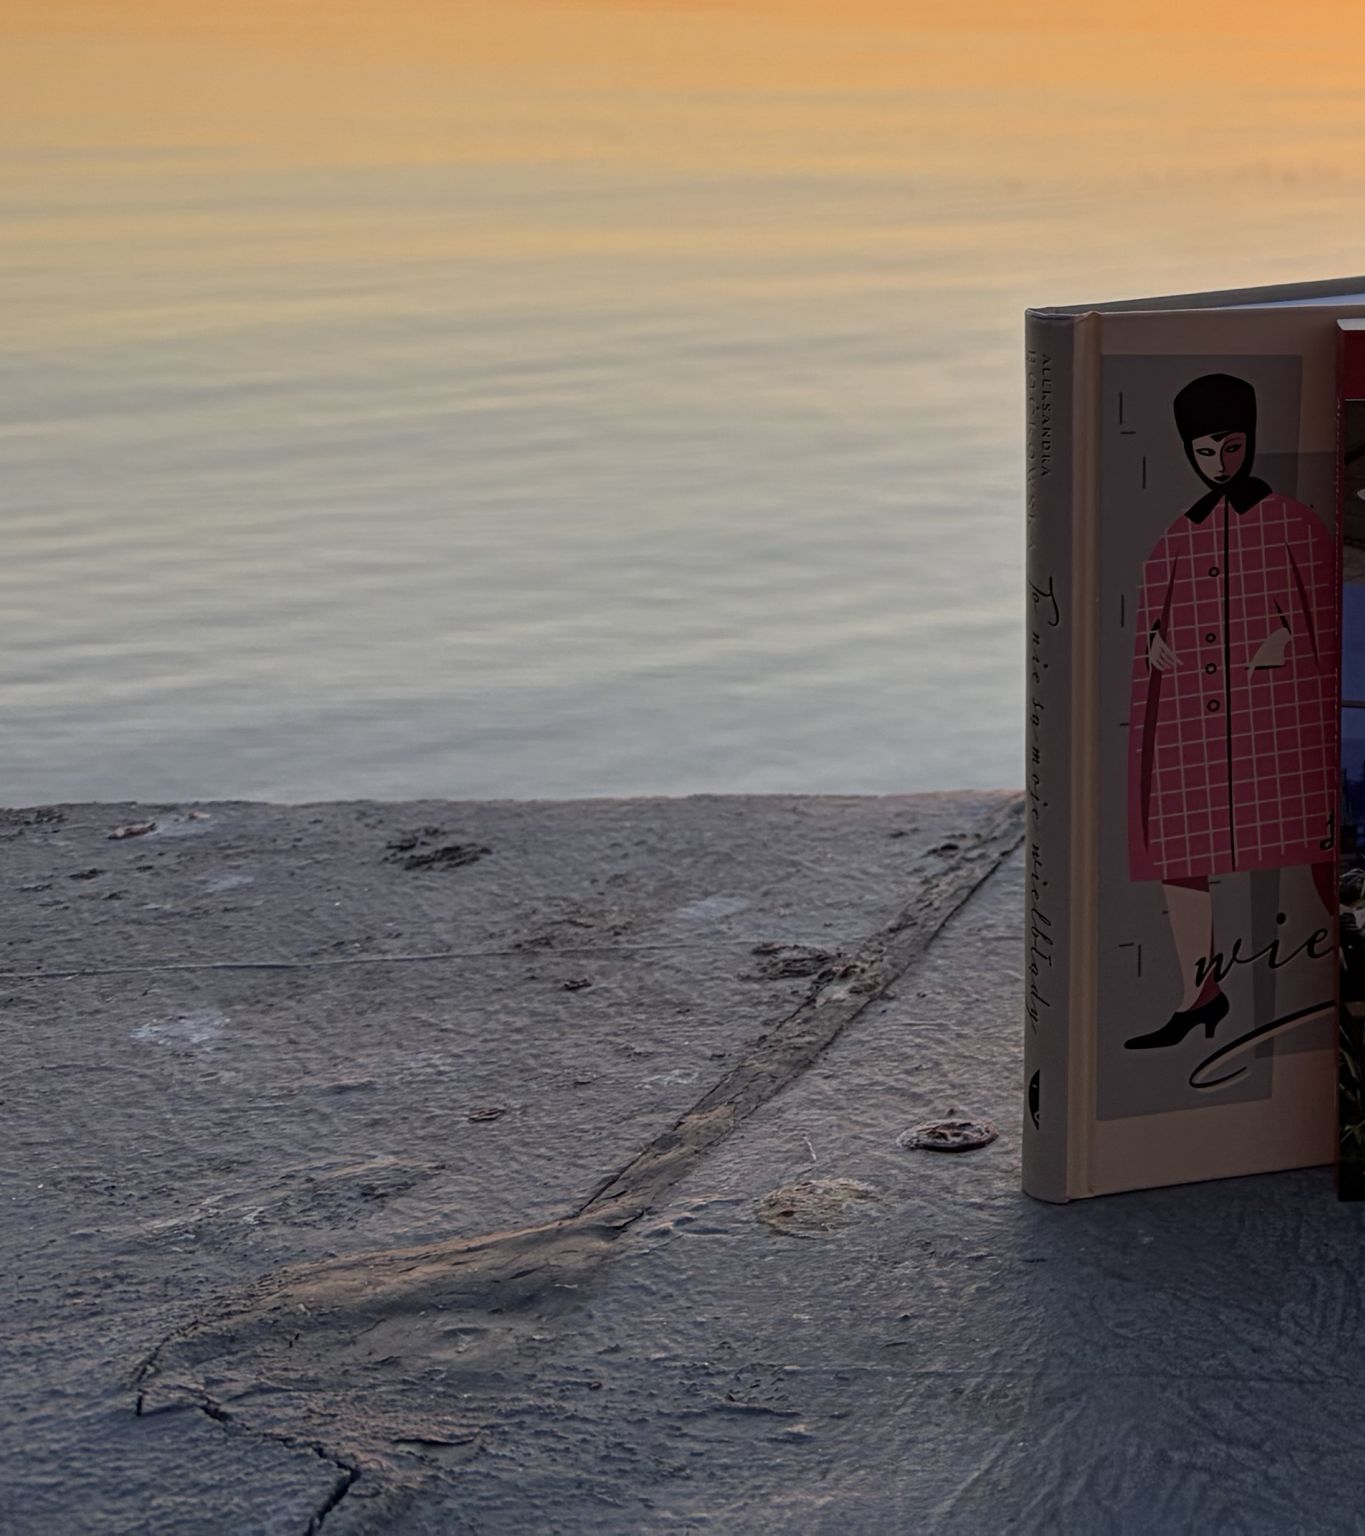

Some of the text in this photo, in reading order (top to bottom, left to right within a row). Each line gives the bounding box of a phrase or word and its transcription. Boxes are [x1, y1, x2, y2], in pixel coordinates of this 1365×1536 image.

[1028, 576, 1060, 626] To
[1031, 631, 1049, 688] nie
[1029, 745, 1048, 826] moje
[1195, 913, 1335, 987] wie
